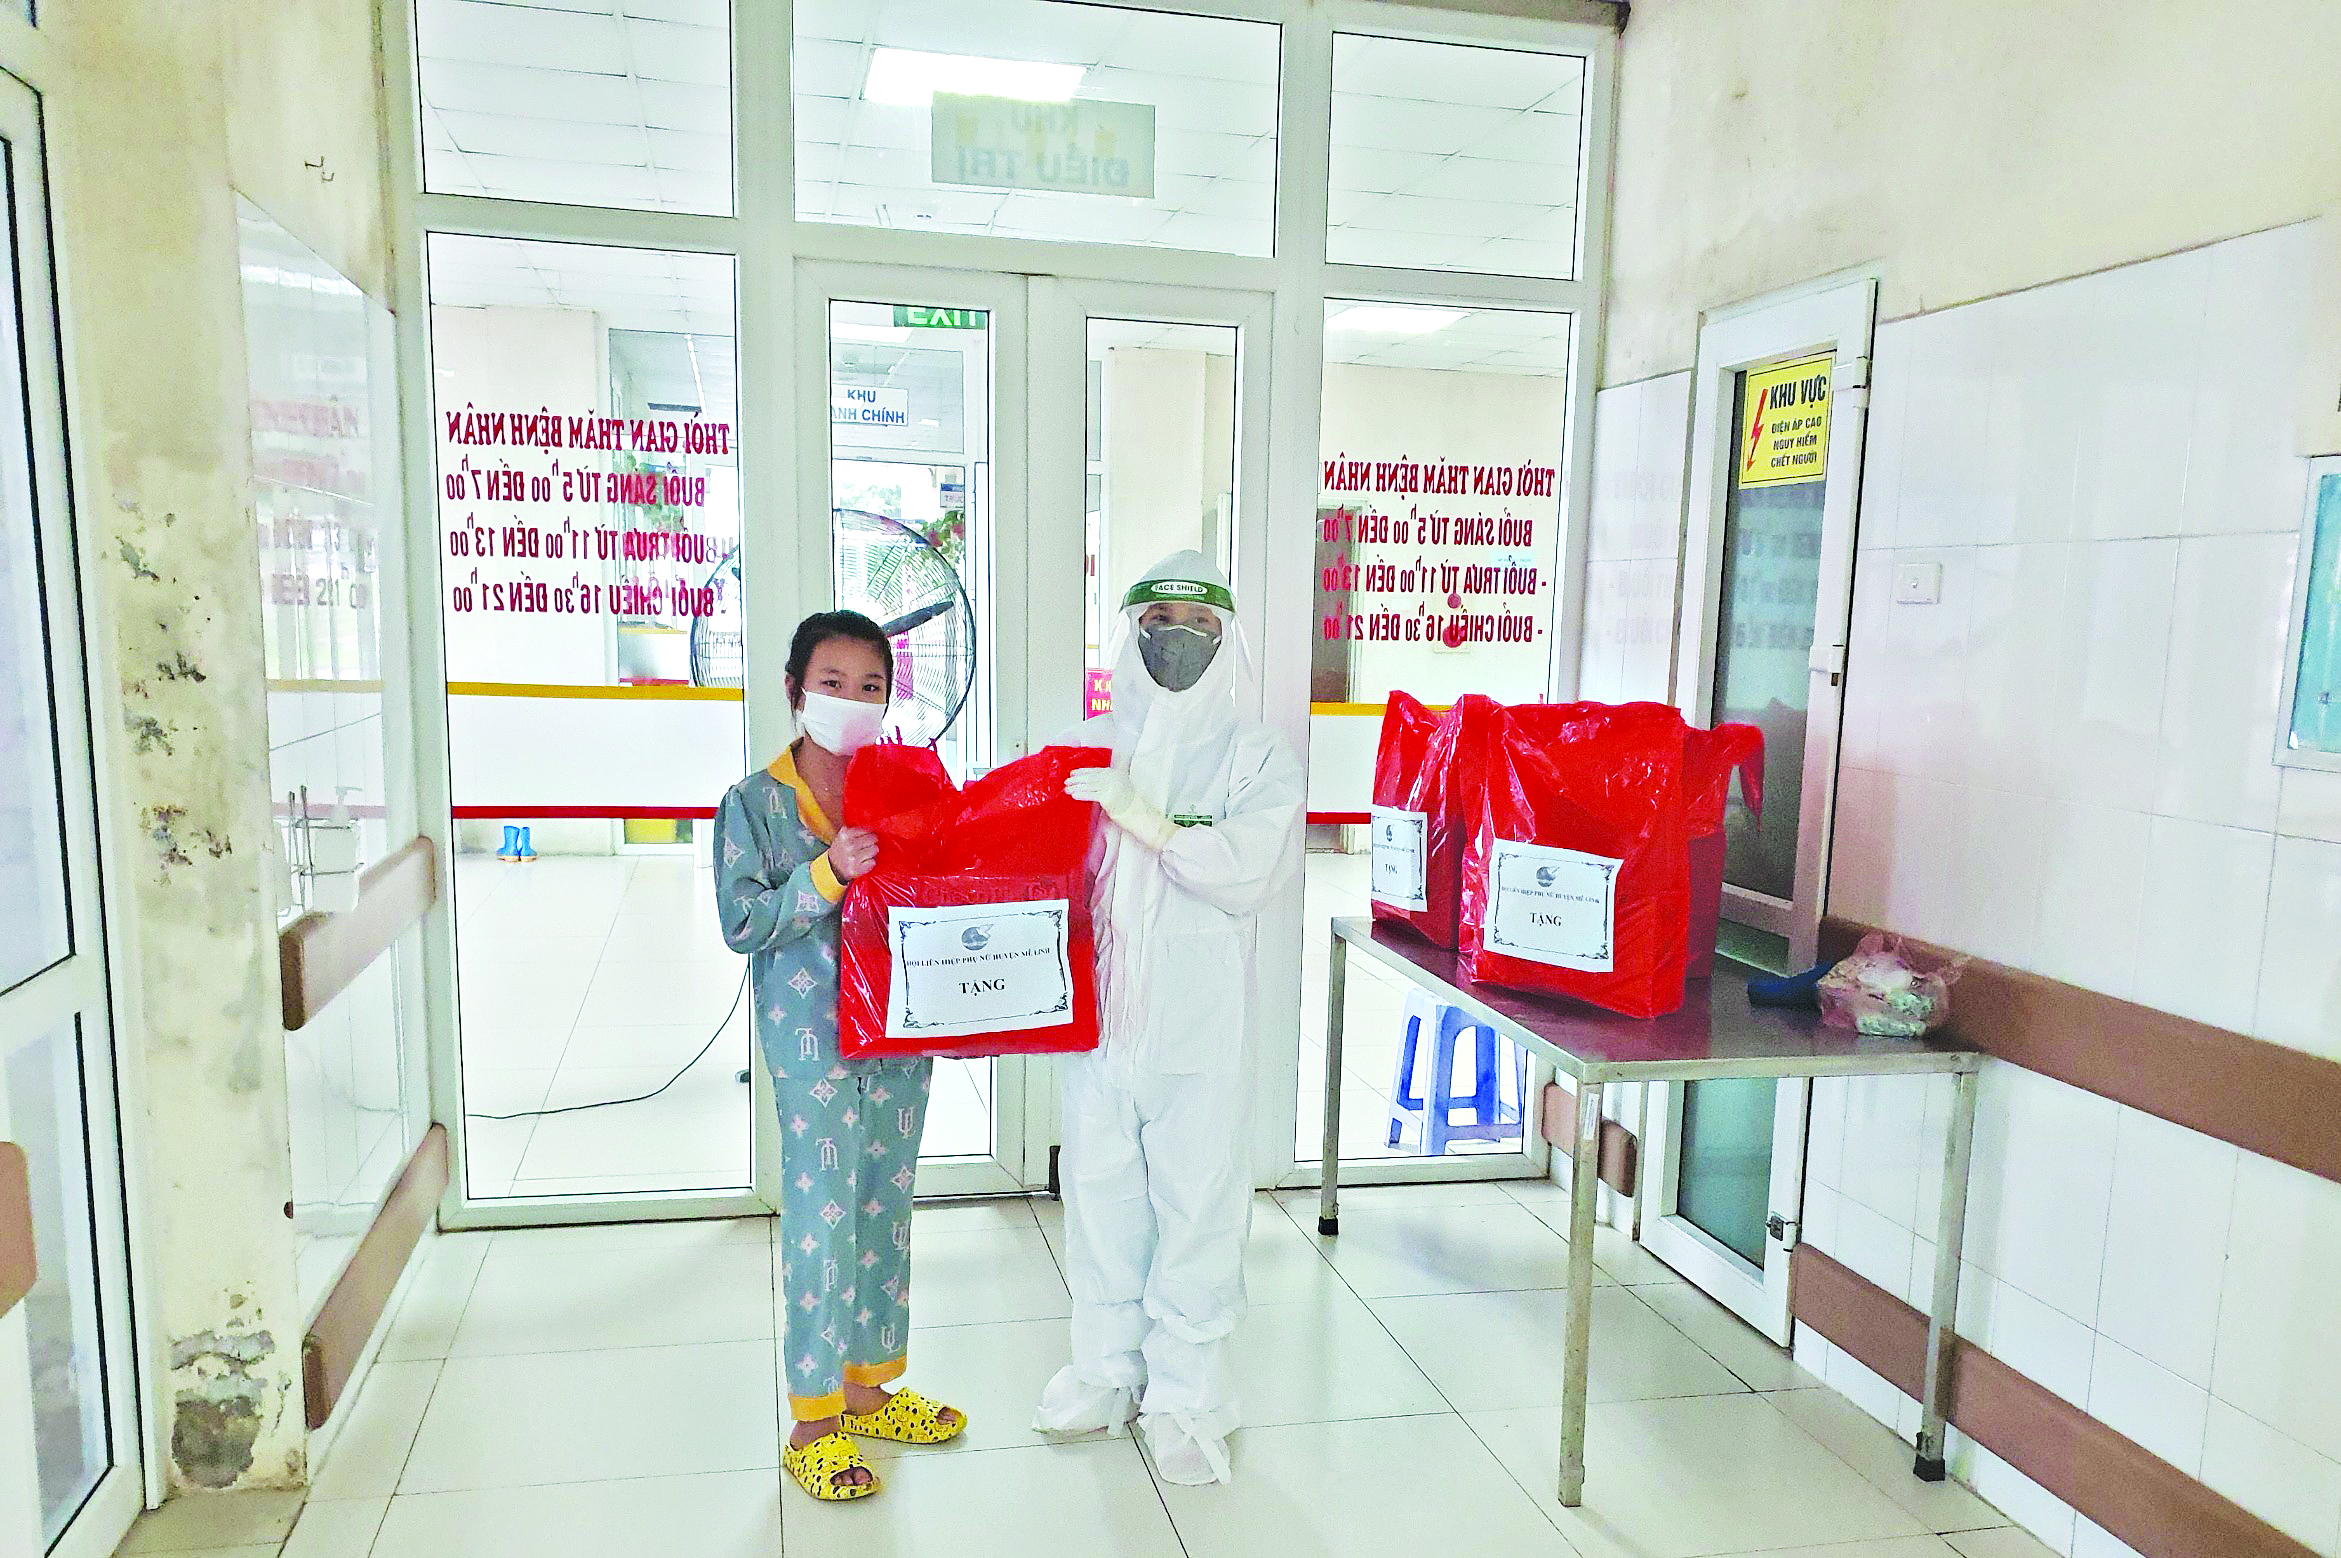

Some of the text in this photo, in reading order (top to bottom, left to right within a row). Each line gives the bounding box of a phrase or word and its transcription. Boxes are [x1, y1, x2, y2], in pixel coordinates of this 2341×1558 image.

[847, 389, 876, 403] KHU
[1770, 374, 1827, 410] KHU VỰC
[862, 406, 905, 424] CHÍNH
[1805, 416, 1822, 428] CAO
[1155, 583, 1204, 593] FACE SHIELD
[1530, 912, 1562, 927] TẶNG
